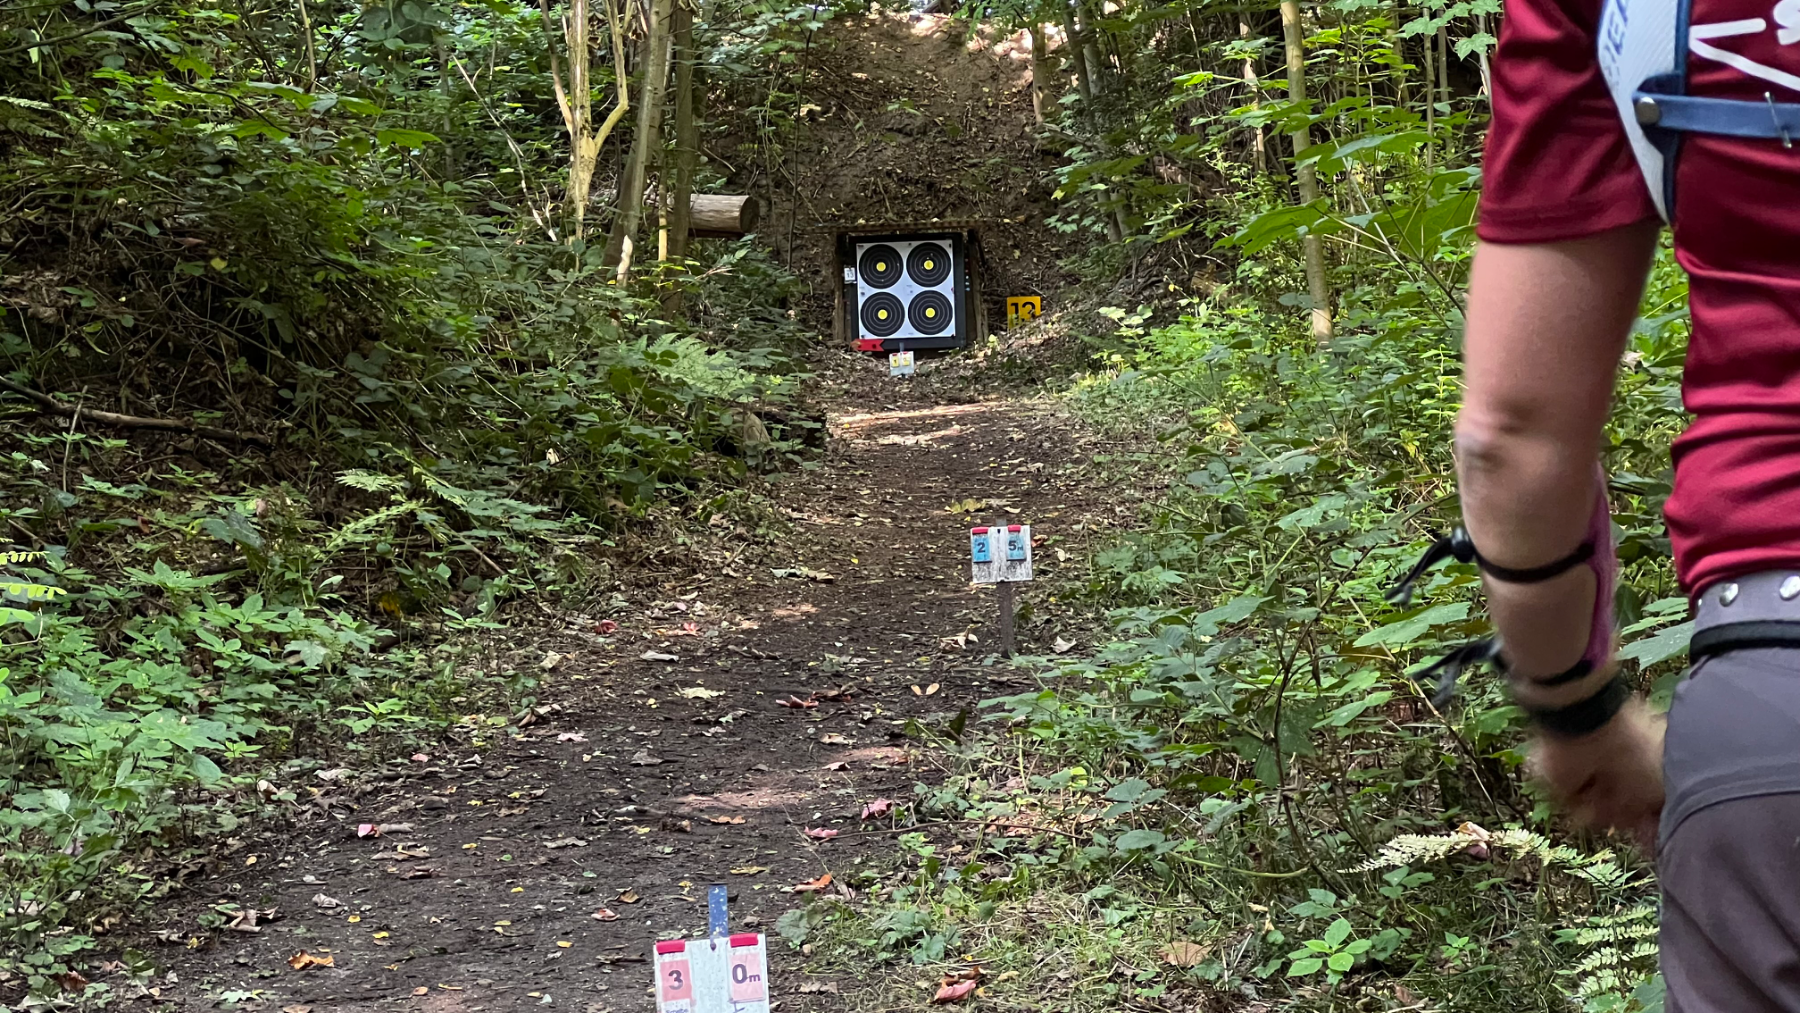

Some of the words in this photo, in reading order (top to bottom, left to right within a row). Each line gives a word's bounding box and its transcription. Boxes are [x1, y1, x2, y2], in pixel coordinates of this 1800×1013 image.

[977, 542, 986, 553] 2
[668, 970, 684, 990] 3
[732, 964, 761, 984] 0m
